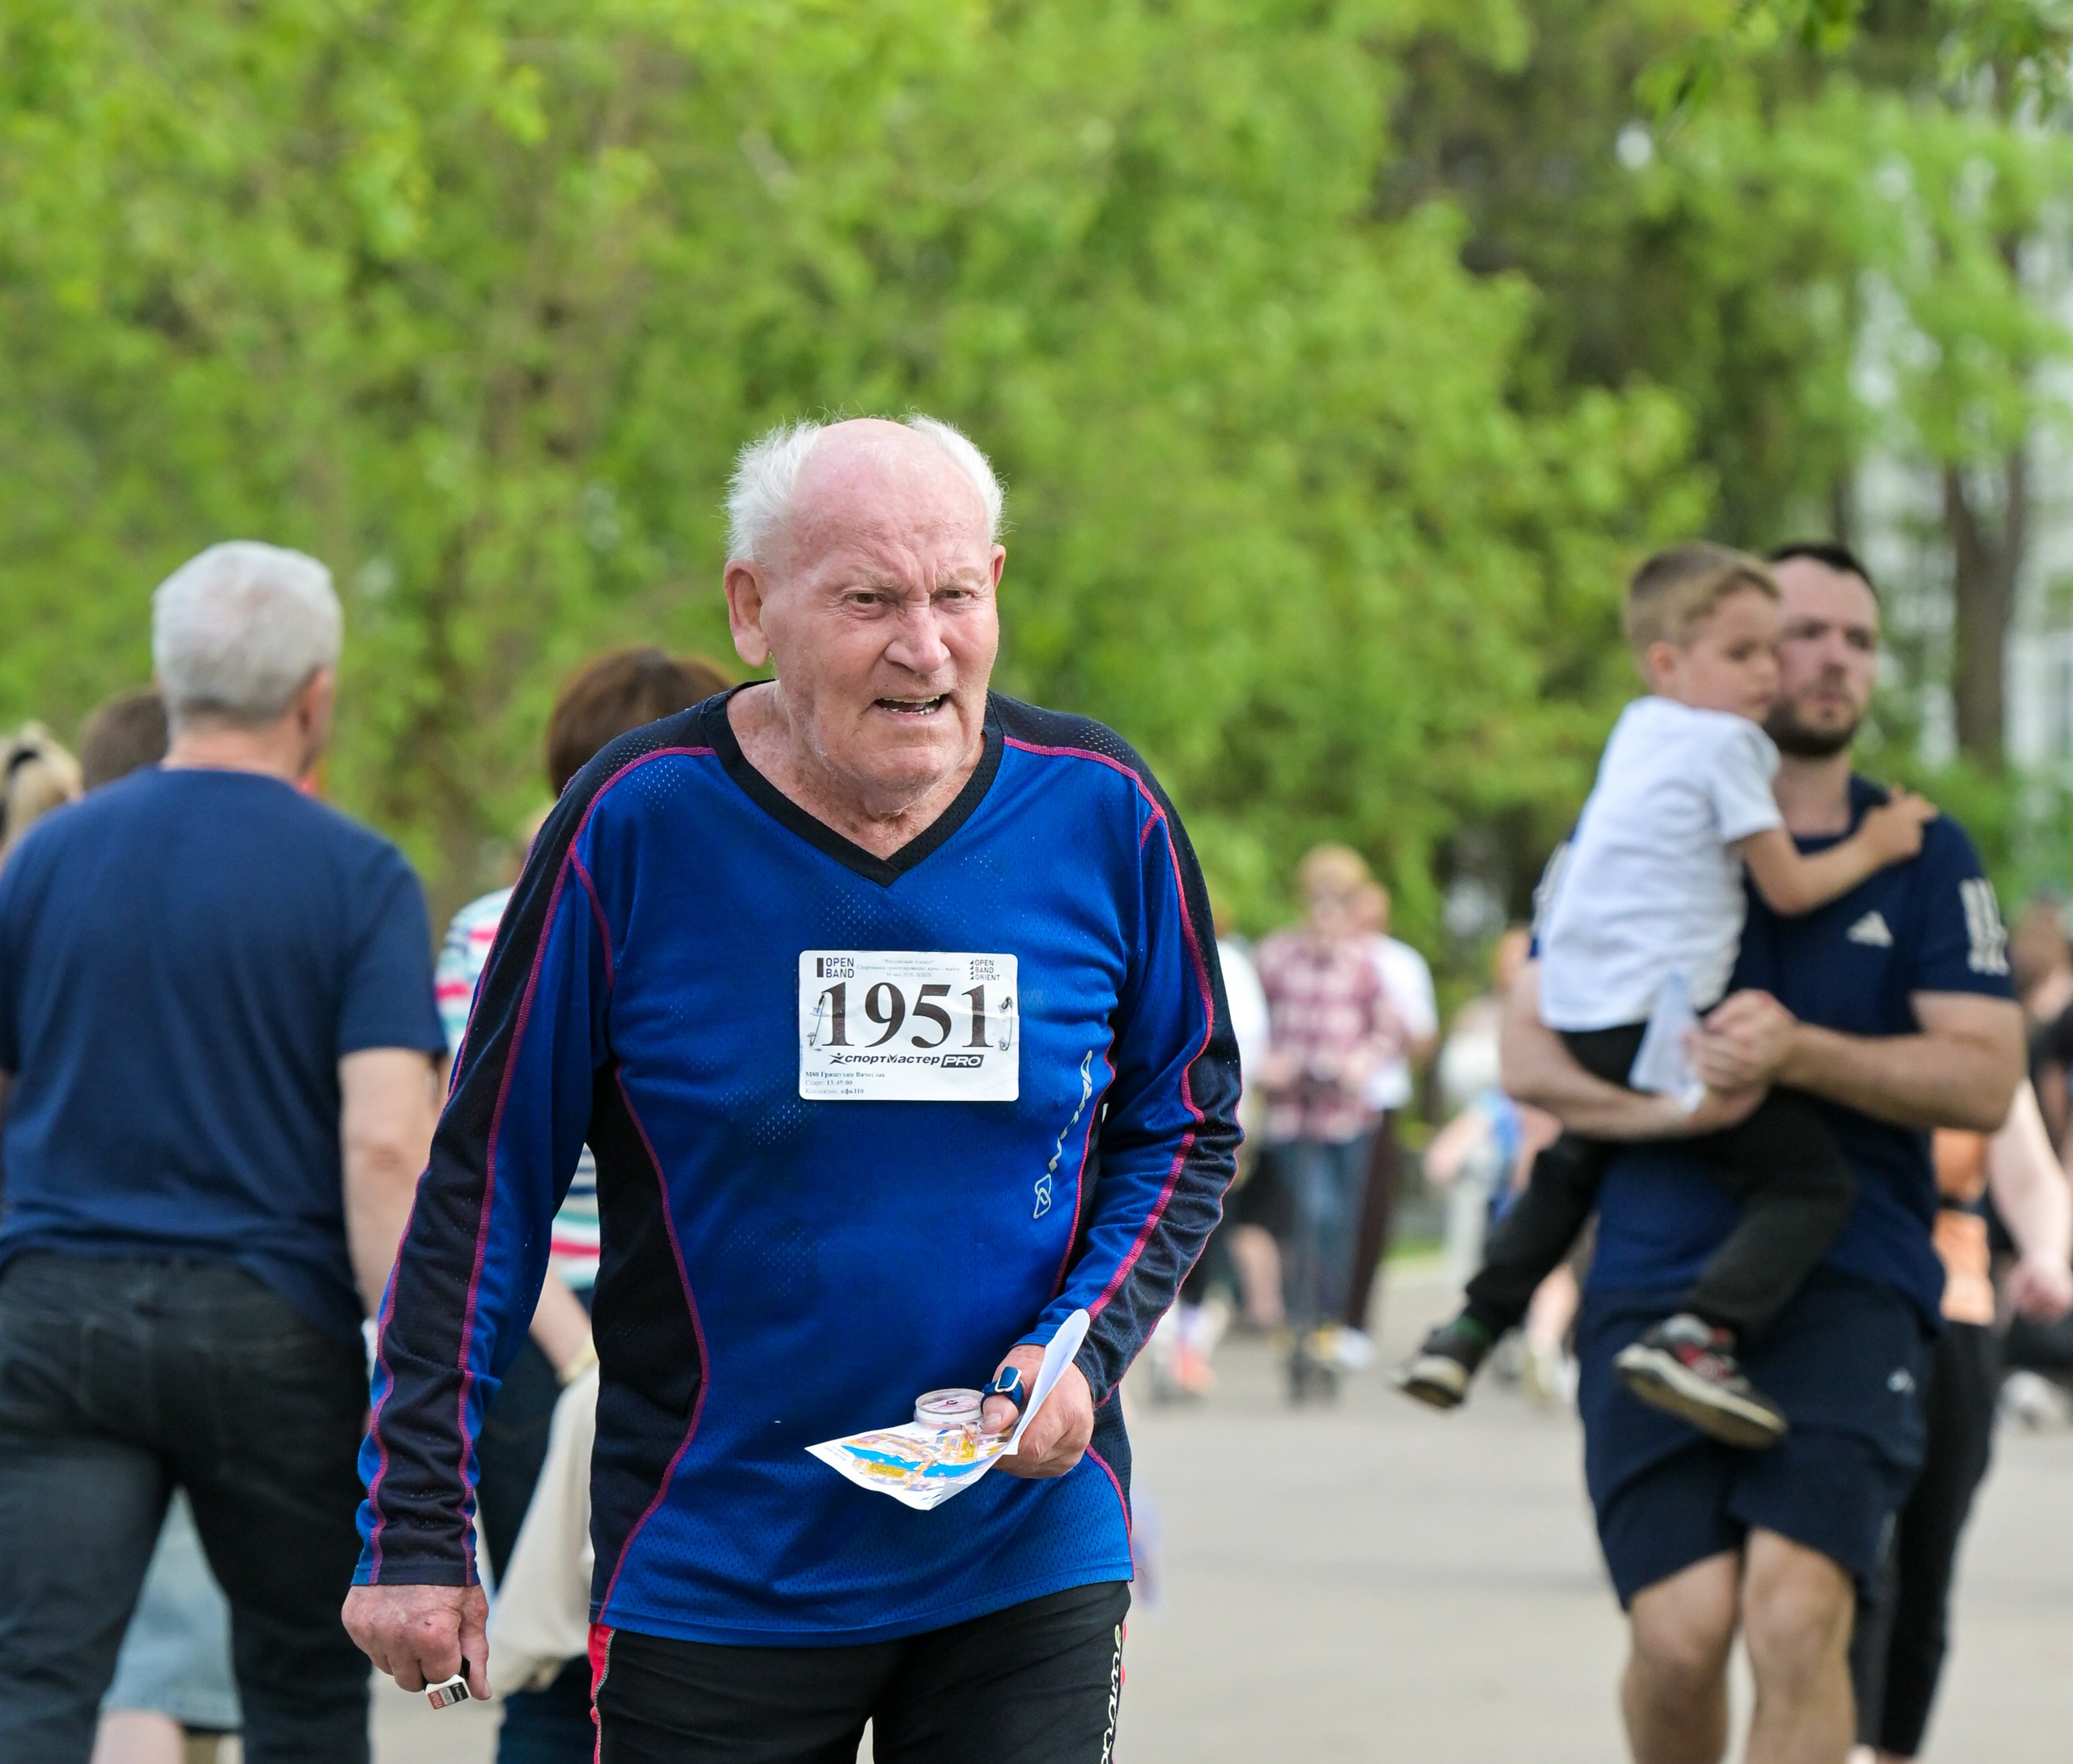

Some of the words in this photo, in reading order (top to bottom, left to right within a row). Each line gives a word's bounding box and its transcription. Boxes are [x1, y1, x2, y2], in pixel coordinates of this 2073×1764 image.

[826, 958, 853, 967] OPEN
[826, 968, 854, 978] BAND
[821, 982, 994, 1048] 1951
[943, 1055, 981, 1067] PRO
